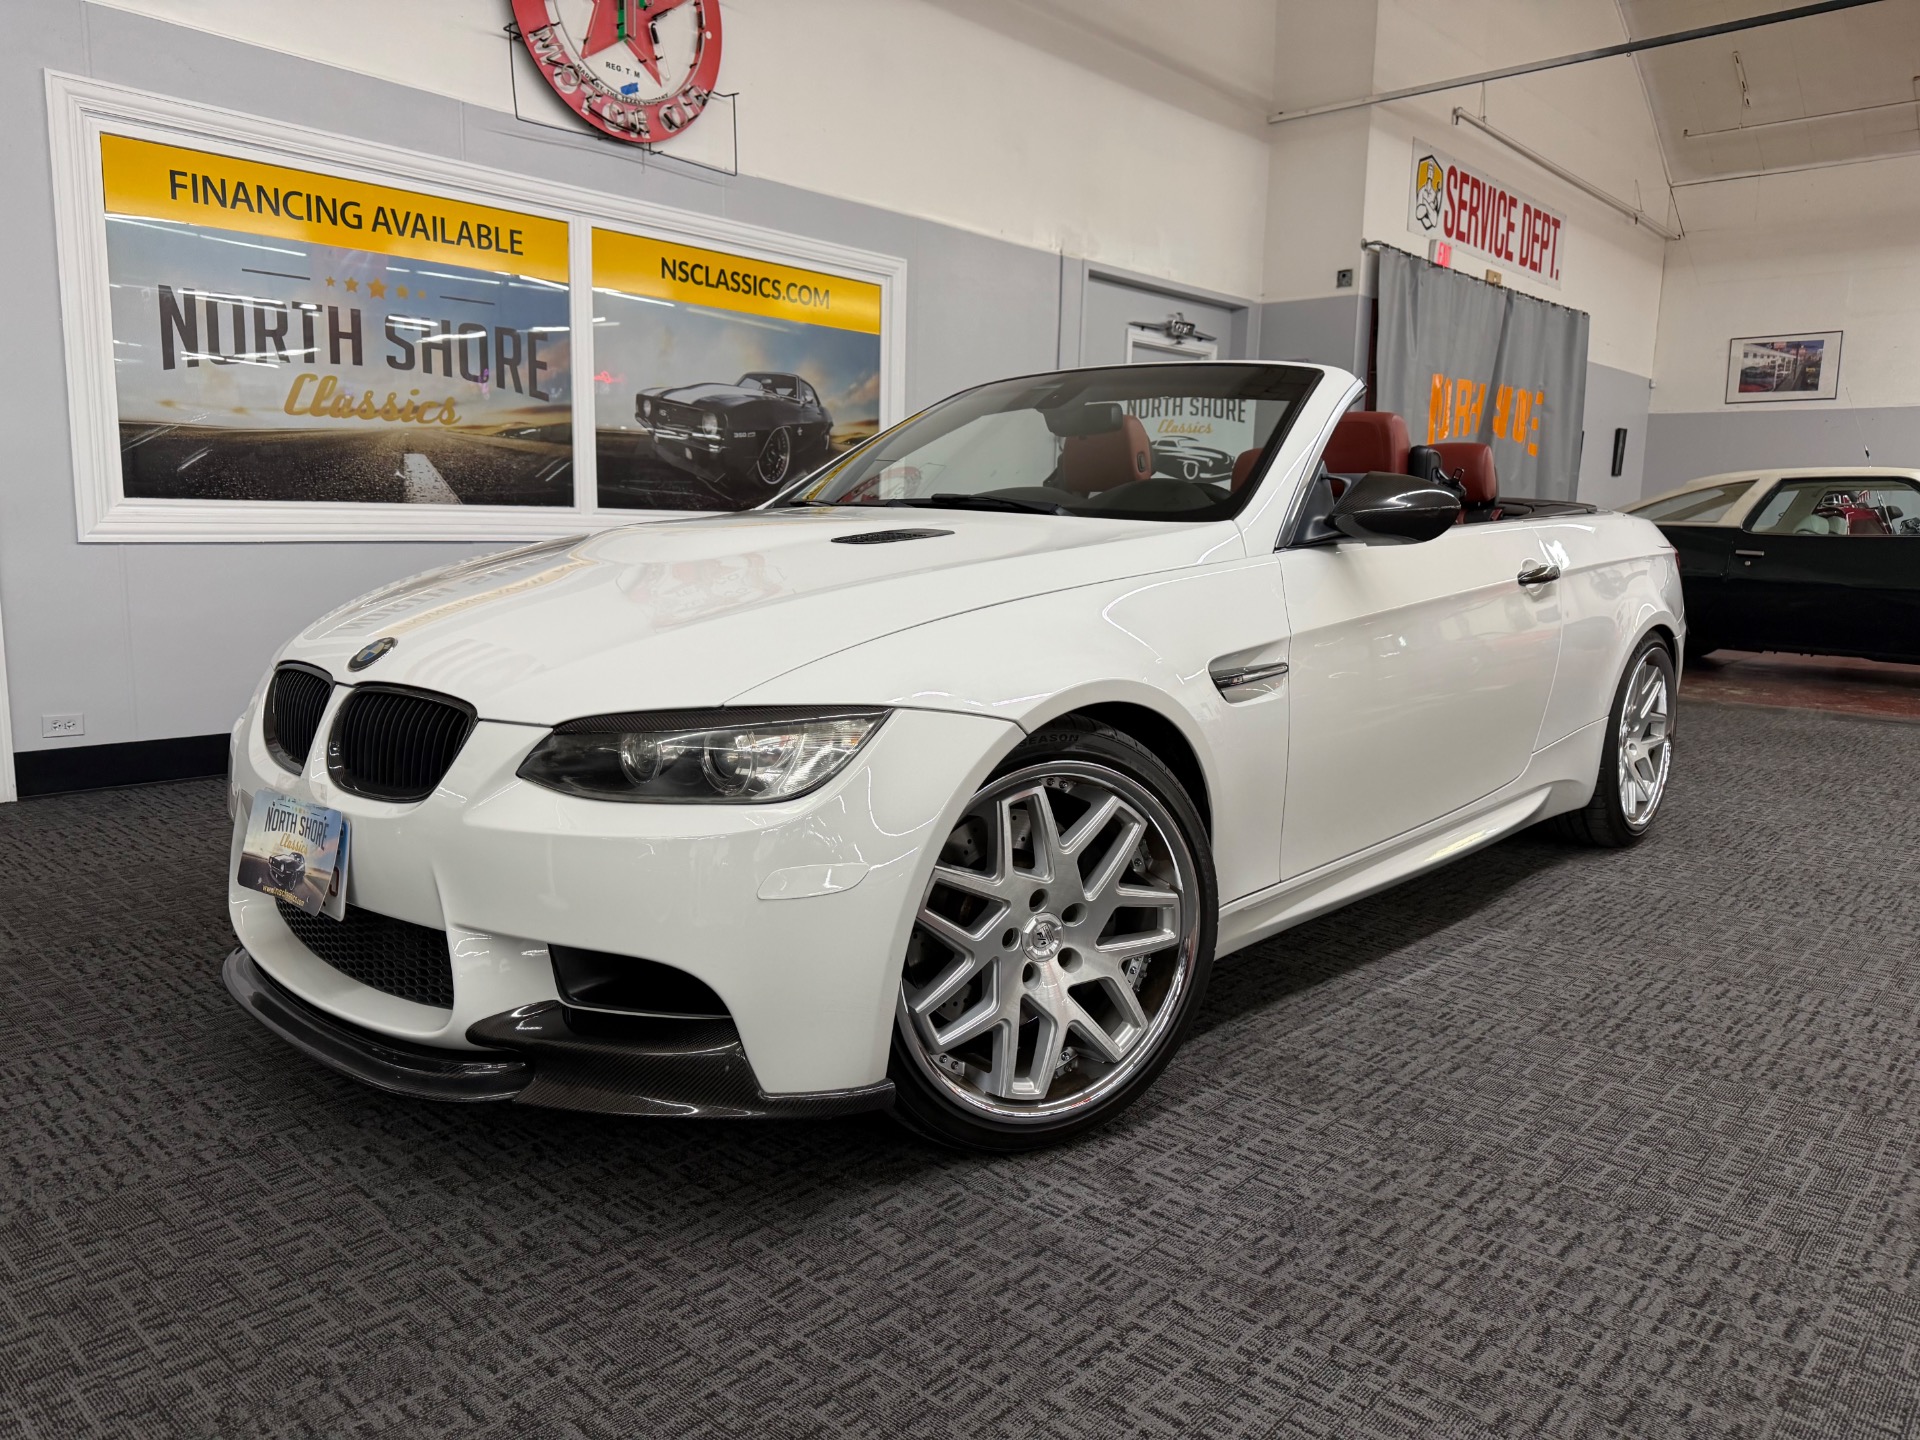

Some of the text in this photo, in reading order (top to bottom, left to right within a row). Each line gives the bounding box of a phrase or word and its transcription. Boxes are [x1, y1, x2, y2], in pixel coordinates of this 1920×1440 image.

[528, 24, 651, 139] MOTOR
[169, 169, 524, 256] FINANCING AVAILABLE
[1443, 165, 1561, 281] SERVICE DEPT.
[660, 256, 830, 310] NSCLASSICS.COM
[158, 284, 550, 403] NORTH SHORE
[283, 372, 461, 426] Classics
[1126, 398, 1247, 423] NORTH SHORE
[1157, 419, 1213, 434] Classics
[264, 808, 330, 850] NORTH SHORE
[279, 832, 309, 856] Classics
